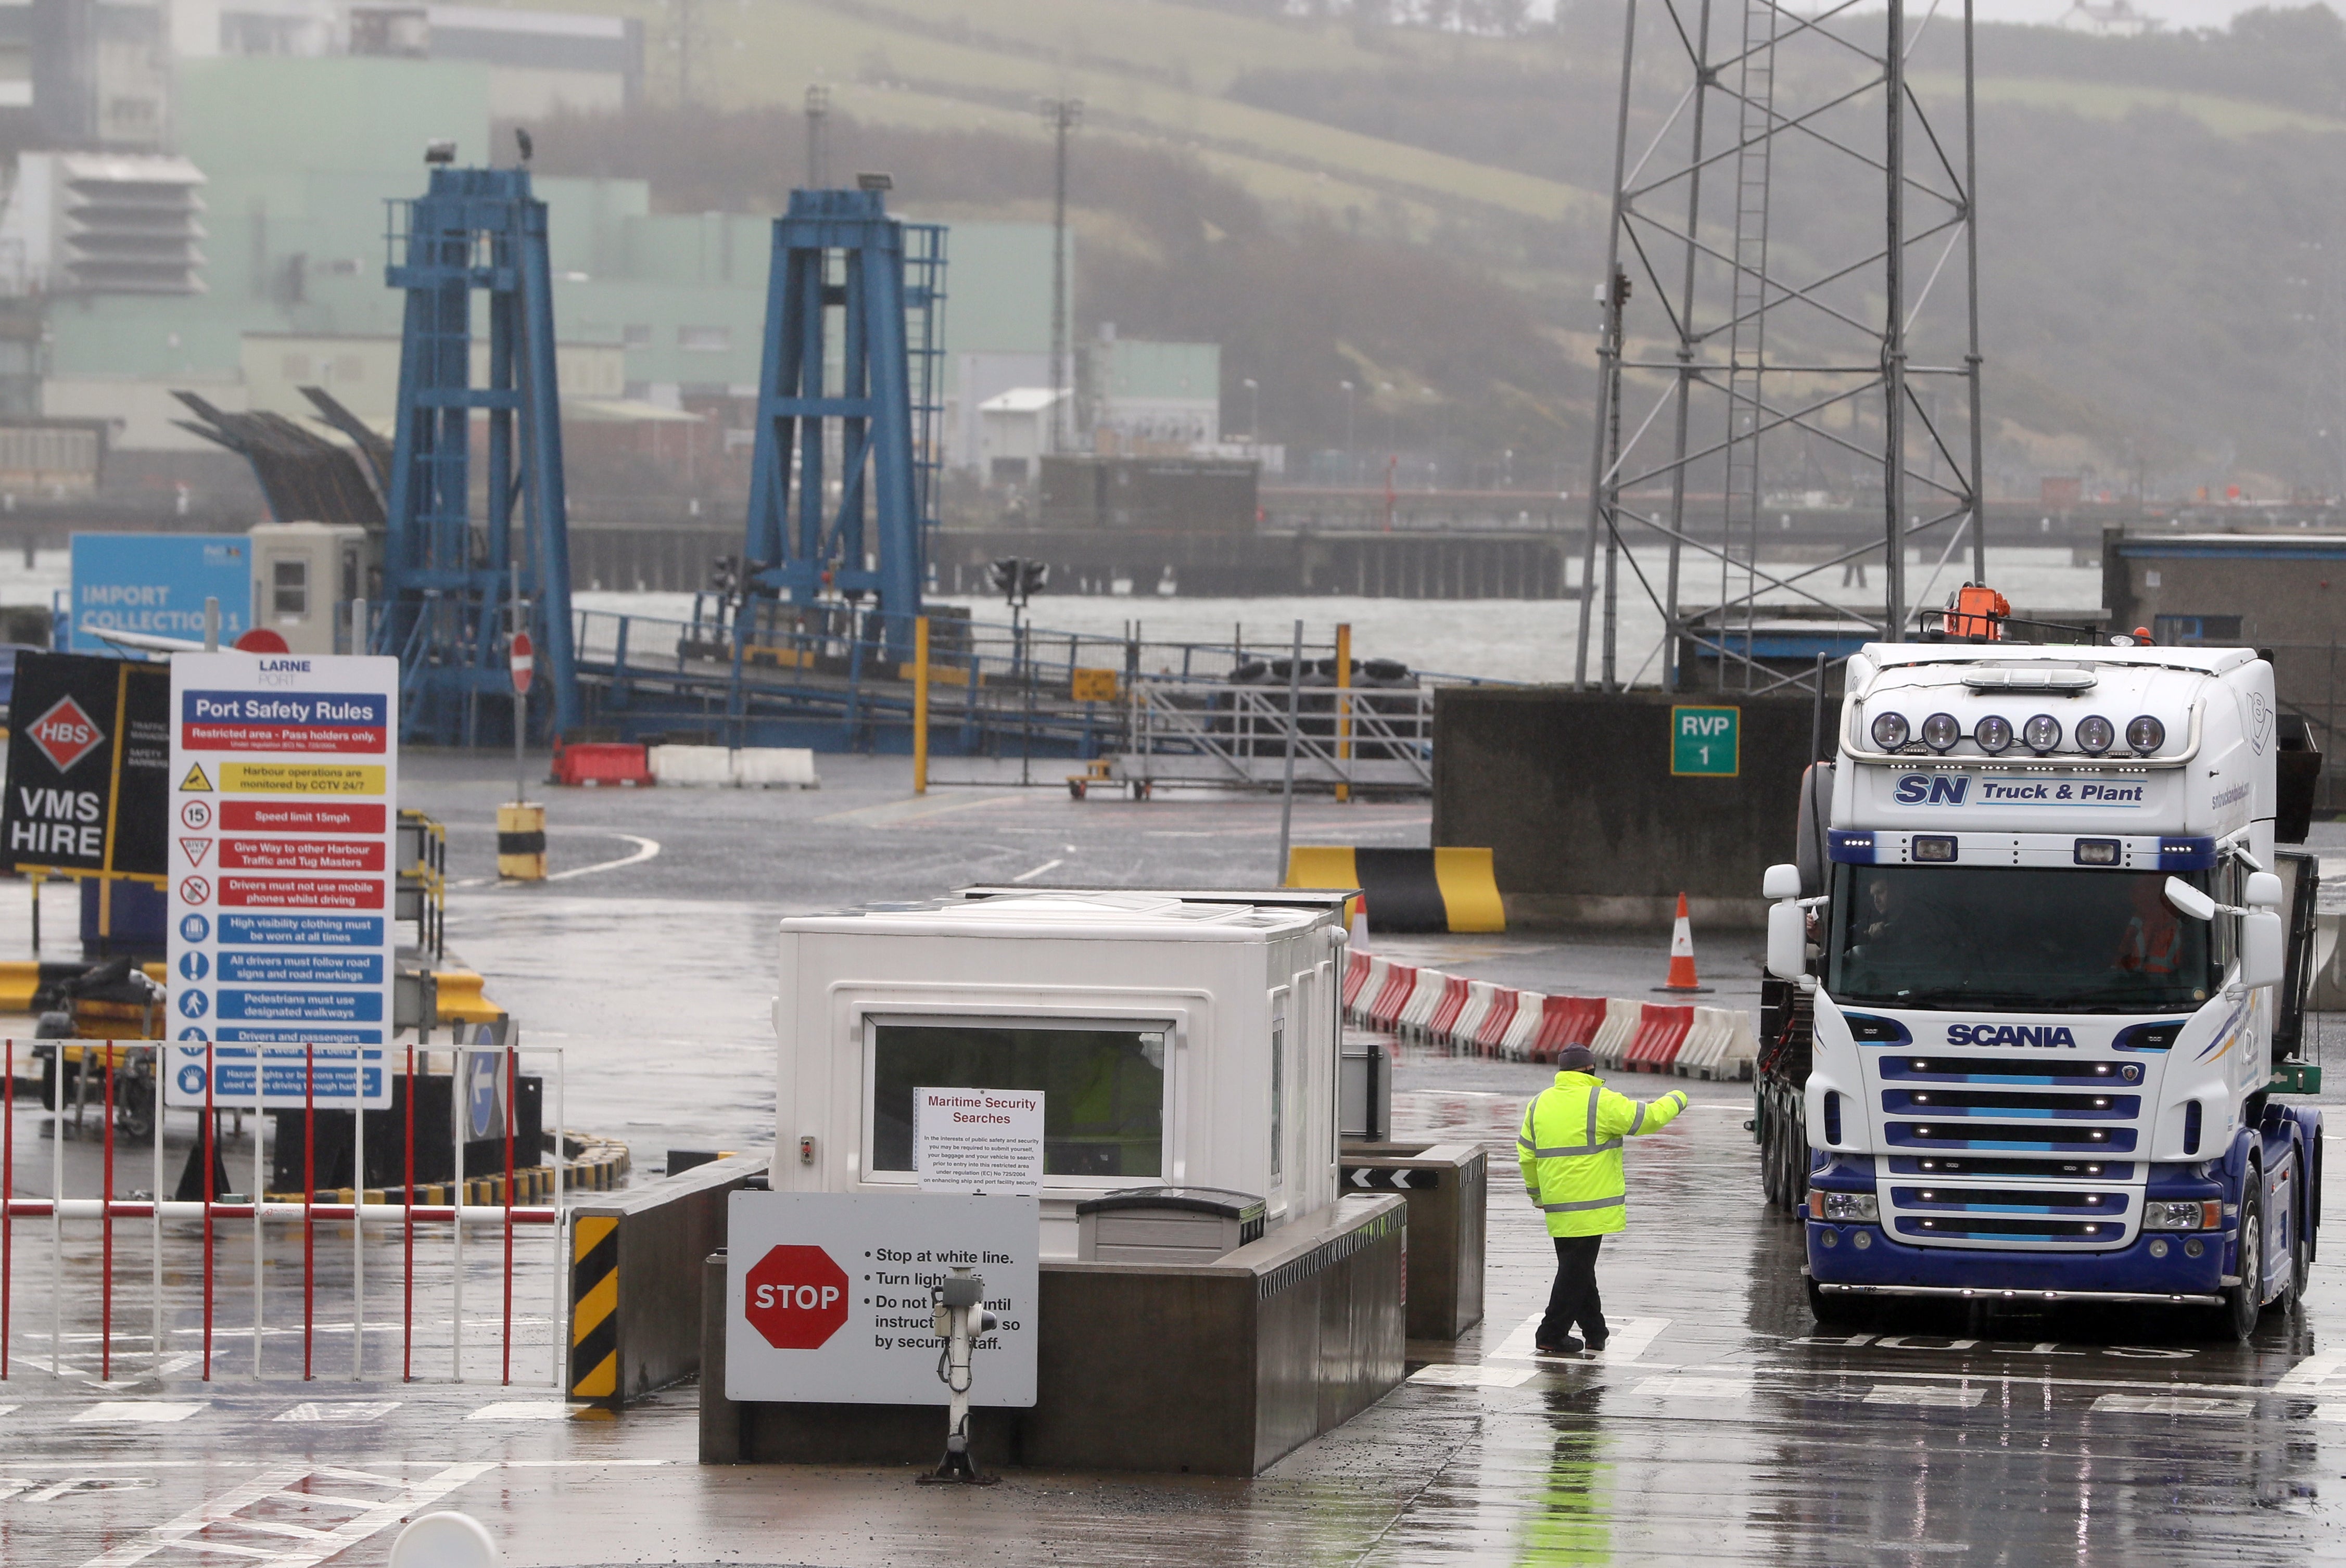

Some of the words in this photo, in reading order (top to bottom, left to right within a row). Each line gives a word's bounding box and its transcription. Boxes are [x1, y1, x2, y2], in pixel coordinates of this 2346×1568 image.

[82, 584, 170, 606] IMPORT
[82, 609, 223, 631] COLLECTIO
[229, 611, 239, 632] 1
[259, 660, 311, 672] LARNE
[259, 674, 295, 686] PORT
[196, 699, 239, 718] Port
[245, 700, 310, 722] Safety
[316, 703, 374, 720] Rules
[41, 722, 90, 744] HBS
[1682, 716, 1730, 736] RVP
[192, 728, 246, 739] Restricted
[282, 730, 307, 740] Pass
[310, 731, 349, 741] holders
[352, 732, 376, 743] only.
[1700, 745, 1709, 766] 1
[244, 767, 284, 776] Harbour
[288, 768, 343, 779] operations
[240, 780, 293, 789] monitored
[296, 781, 307, 791] by
[310, 781, 340, 789] CCTV
[343, 782, 364, 791] 24/7
[1895, 774, 1971, 805] SN
[1983, 783, 2047, 800] Truck
[2056, 784, 2073, 799] &
[2081, 784, 2143, 801] Plant
[20, 786, 100, 822] VMS
[188, 808, 204, 822] 15
[255, 811, 288, 822] Speed
[290, 812, 312, 822] limit
[316, 813, 350, 824] 15mph
[11, 820, 103, 858] HIRE
[234, 843, 258, 853] Give
[260, 843, 282, 855] Way
[284, 845, 296, 853] to
[298, 845, 325, 854] other
[328, 845, 370, 855] Harbour
[242, 855, 274, 865] Traffic
[276, 857, 296, 866] and
[299, 858, 317, 869] Tug
[320, 858, 362, 867] Masters
[230, 880, 266, 890] Drivers
[269, 882, 295, 891] must
[297, 883, 314, 891] not
[338, 883, 373, 893] mobile
[247, 895, 285, 904] phones
[287, 895, 318, 904] whilst
[321, 896, 356, 906] driving
[231, 918, 255, 929] High
[257, 919, 298, 930] visibility
[301, 919, 343, 931] clothing
[346, 921, 371, 930] must
[250, 931, 263, 940] be
[295, 933, 306, 941] at
[308, 933, 320, 941] all
[322, 933, 351, 942] times
[231, 955, 244, 965] All
[246, 957, 282, 966] drivers
[284, 958, 310, 966] must
[313, 958, 344, 967] follow
[346, 958, 370, 967] road
[237, 969, 264, 979] signs
[267, 970, 286, 979] and
[289, 970, 312, 979] road
[315, 971, 363, 981] markings
[244, 993, 305, 1004] Pedestrians
[308, 996, 334, 1005] must
[336, 997, 354, 1005] use
[244, 1007, 301, 1017] designated
[304, 1009, 354, 1019] walkways
[238, 1031, 275, 1041] Drivers
[278, 1033, 297, 1042] and
[299, 1034, 360, 1043] passengers
[1946, 1024, 2076, 1049] SCANIA
[223, 1081, 245, 1089] used
[272, 1081, 302, 1092] driving
[929, 1095, 981, 1107] Maritime
[985, 1097, 1036, 1111] Security
[953, 1112, 1010, 1124] Searches
[876, 1248, 911, 1264] Stop
[917, 1250, 932, 1262] at
[936, 1251, 978, 1263] white
[983, 1251, 1013, 1264] line.
[876, 1272, 909, 1285] Turn
[915, 1273, 946, 1288] ligh
[755, 1284, 839, 1310] STOP
[876, 1295, 897, 1308] Do
[903, 1297, 927, 1309] not
[876, 1315, 936, 1328] instruct
[1003, 1321, 1020, 1330] so
[875, 1335, 893, 1349] by
